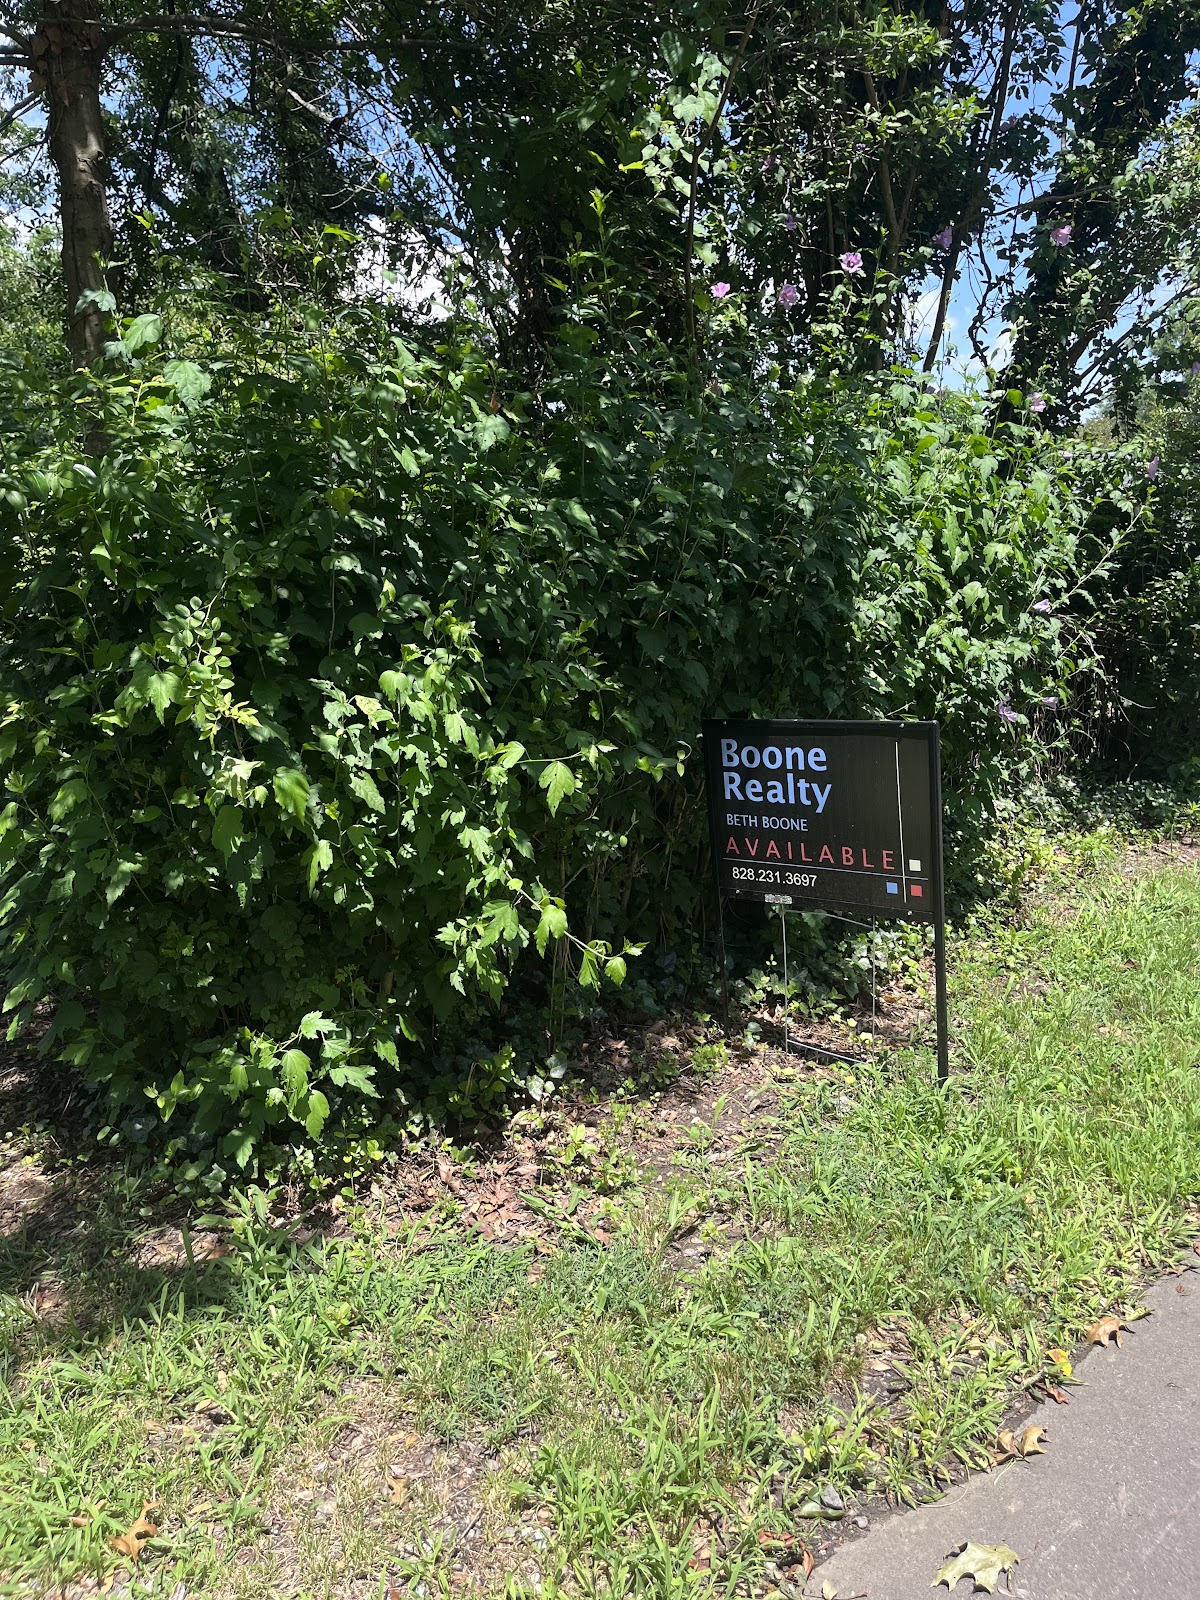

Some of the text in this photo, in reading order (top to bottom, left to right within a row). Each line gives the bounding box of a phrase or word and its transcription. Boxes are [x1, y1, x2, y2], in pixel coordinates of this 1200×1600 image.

[721, 738, 828, 772] Boone
[723, 771, 832, 813] Realty
[726, 813, 808, 832] BETH BOONE
[725, 836, 895, 870] AVAILABLE
[732, 866, 817, 887] 828.231.3697
